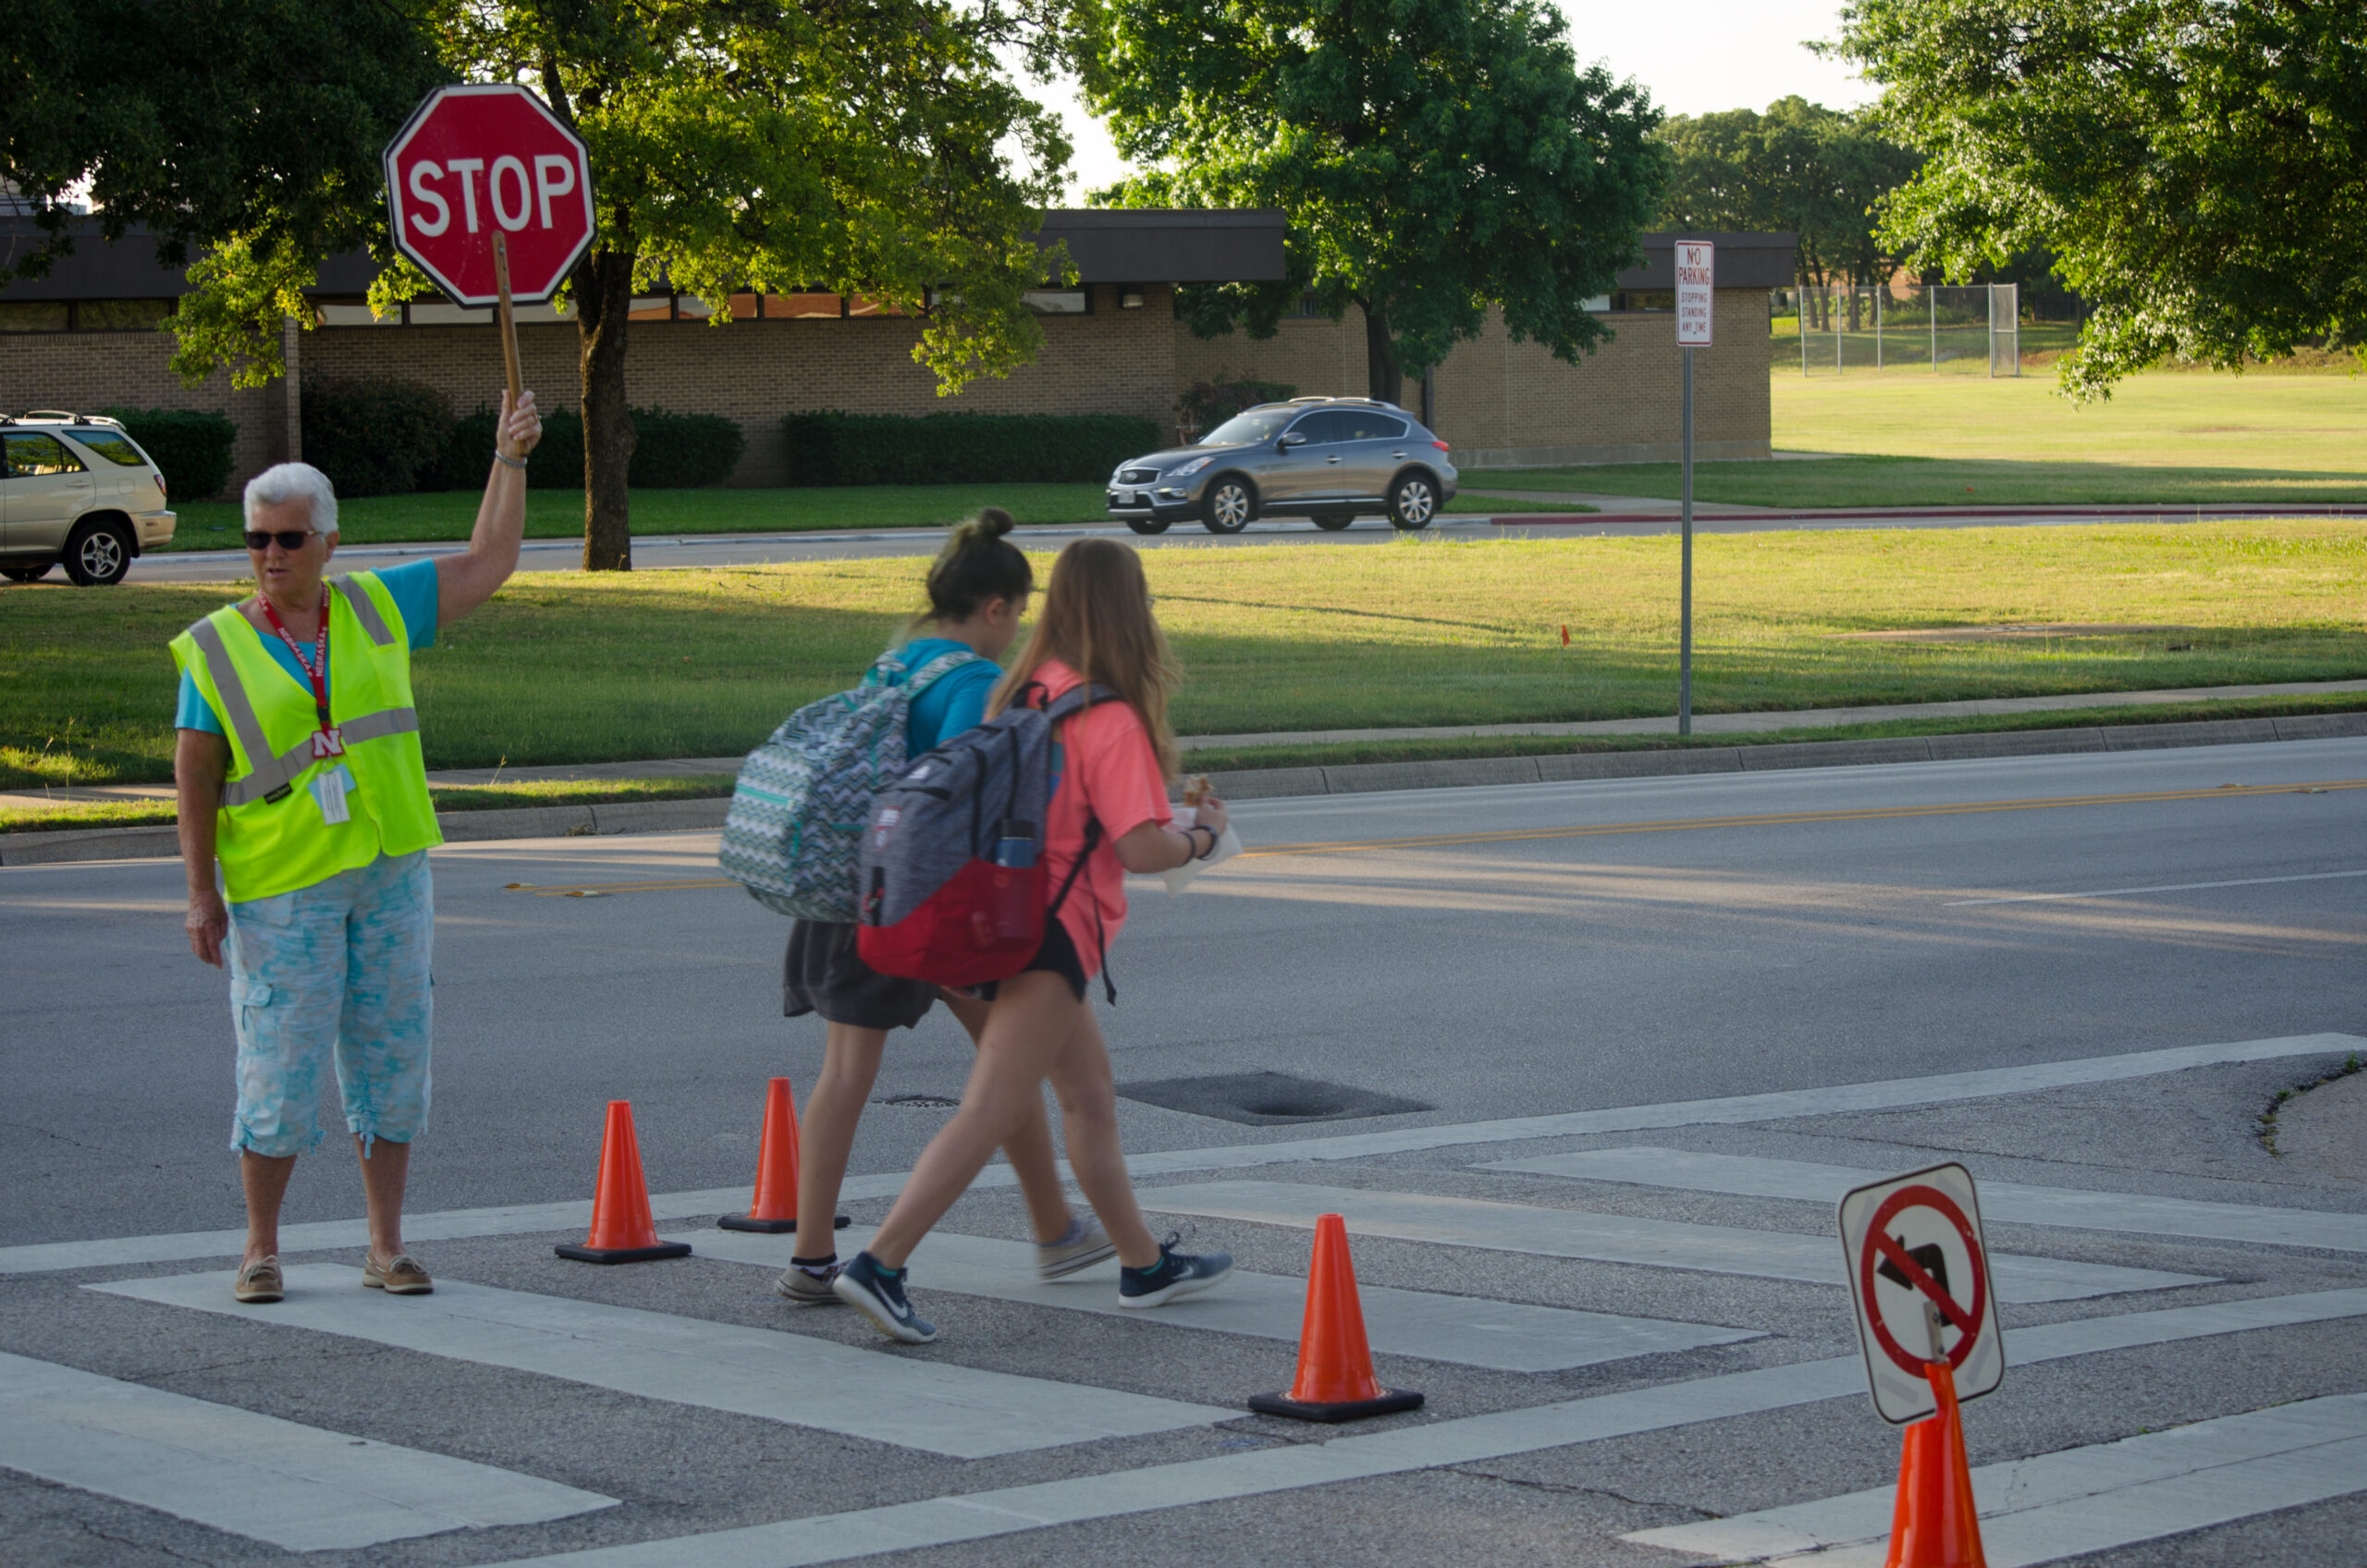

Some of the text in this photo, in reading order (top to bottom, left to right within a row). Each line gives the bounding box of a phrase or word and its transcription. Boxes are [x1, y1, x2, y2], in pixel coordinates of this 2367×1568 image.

[409, 154, 576, 238] STOP
[1686, 247, 1701, 265] NO
[1678, 267, 1710, 286] PARKING
[1681, 292, 1708, 303] STOPPING
[1682, 306, 1707, 318] STANDING
[1682, 322, 1707, 333] ANY TIME
[278, 627, 311, 671] NEBRASKA
[316, 632, 326, 676] NEBRASKA
[313, 729, 344, 757] N
